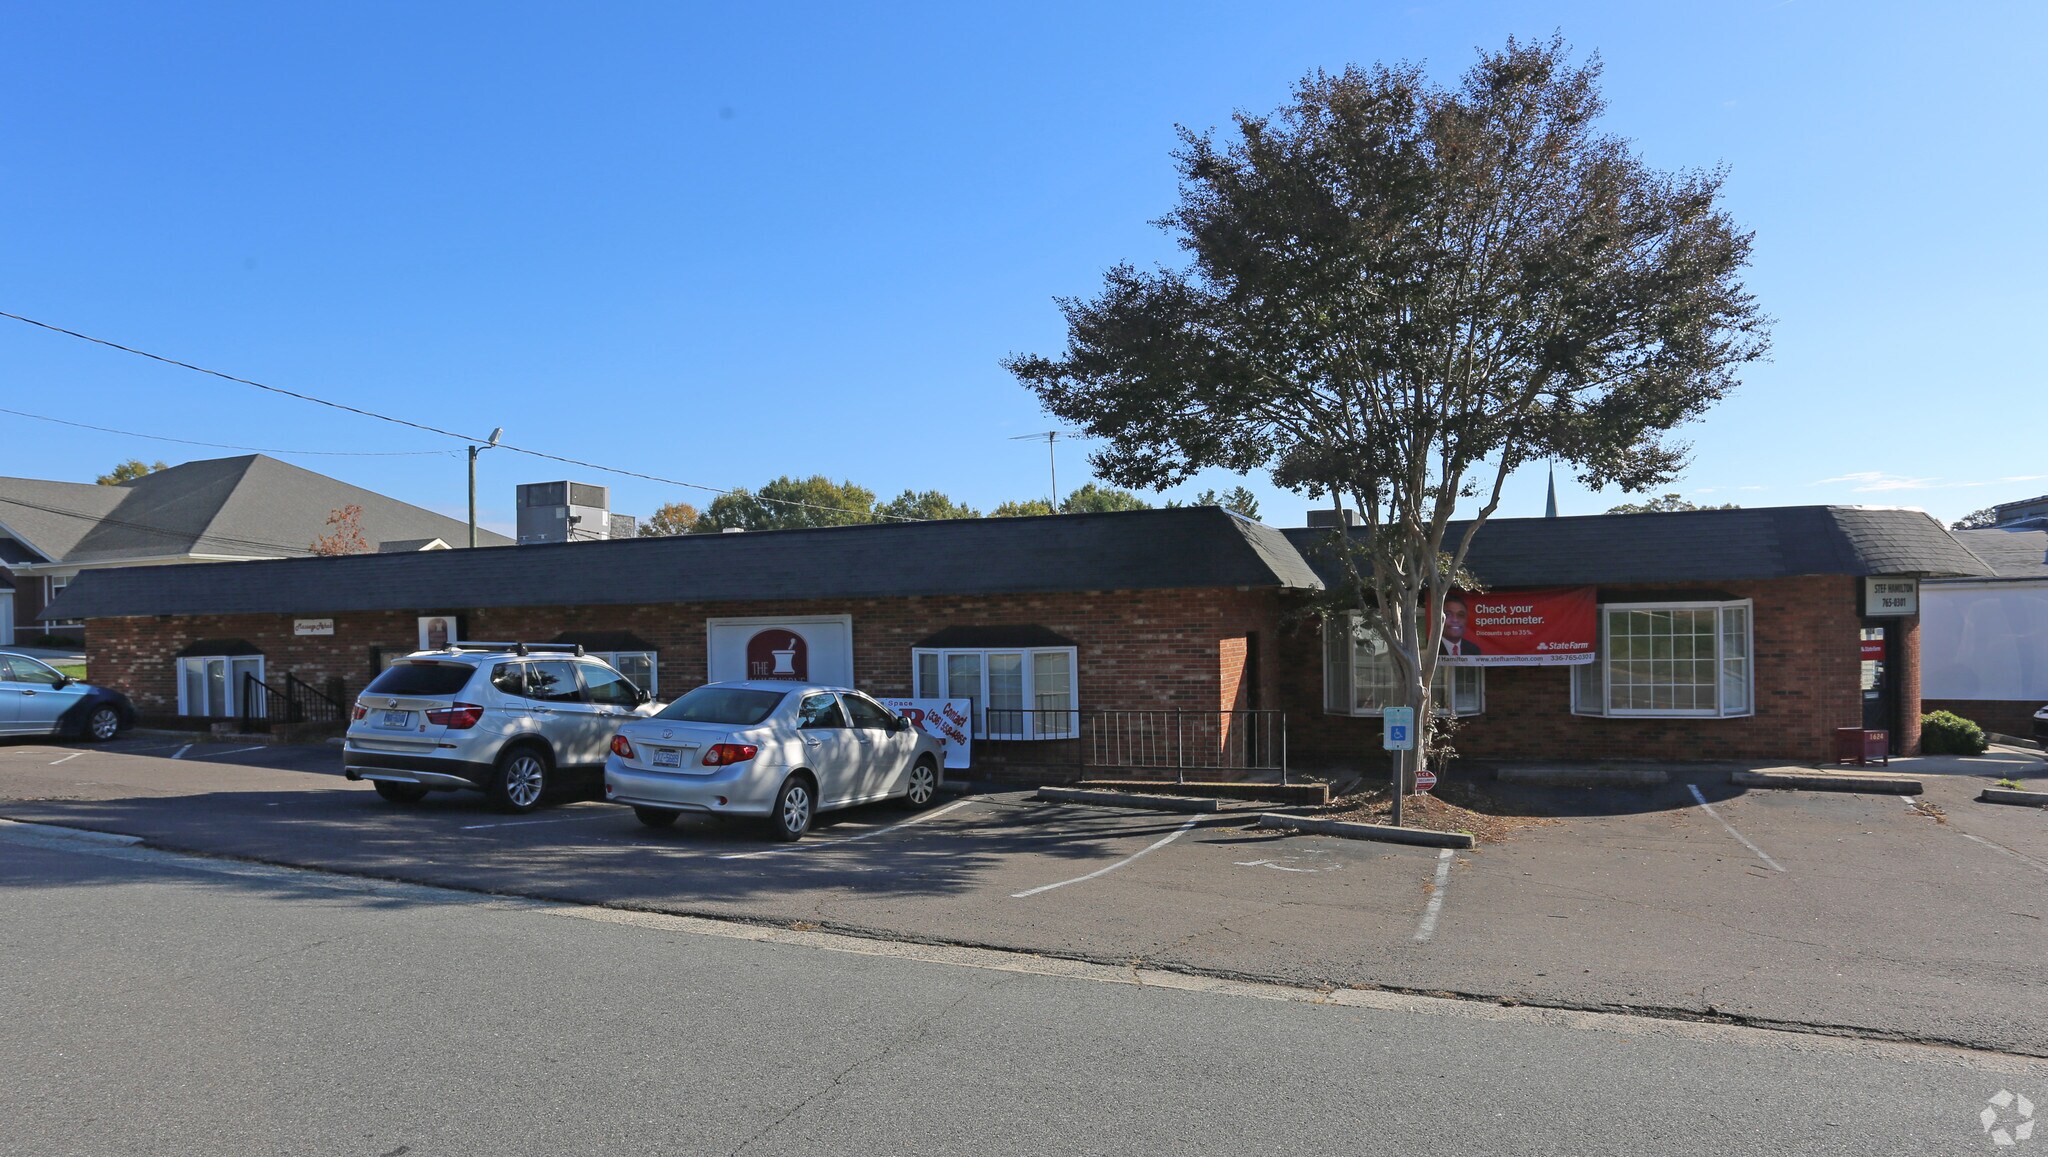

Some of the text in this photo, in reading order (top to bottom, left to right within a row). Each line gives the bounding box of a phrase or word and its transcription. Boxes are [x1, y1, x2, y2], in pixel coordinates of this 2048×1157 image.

[1874, 583, 1914, 593] STEF HAMILTON
[1882, 598, 1906, 607] 765-0301
[1475, 604, 1533, 615] Check your
[1475, 616, 1545, 627] spendometer.
[1549, 641, 1589, 650] State Farm
[1551, 653, 1592, 661] 336-765-0301
[751, 661, 769, 675] THE
[926, 708, 944, 729] (336)
[943, 702, 968, 728] Contact
